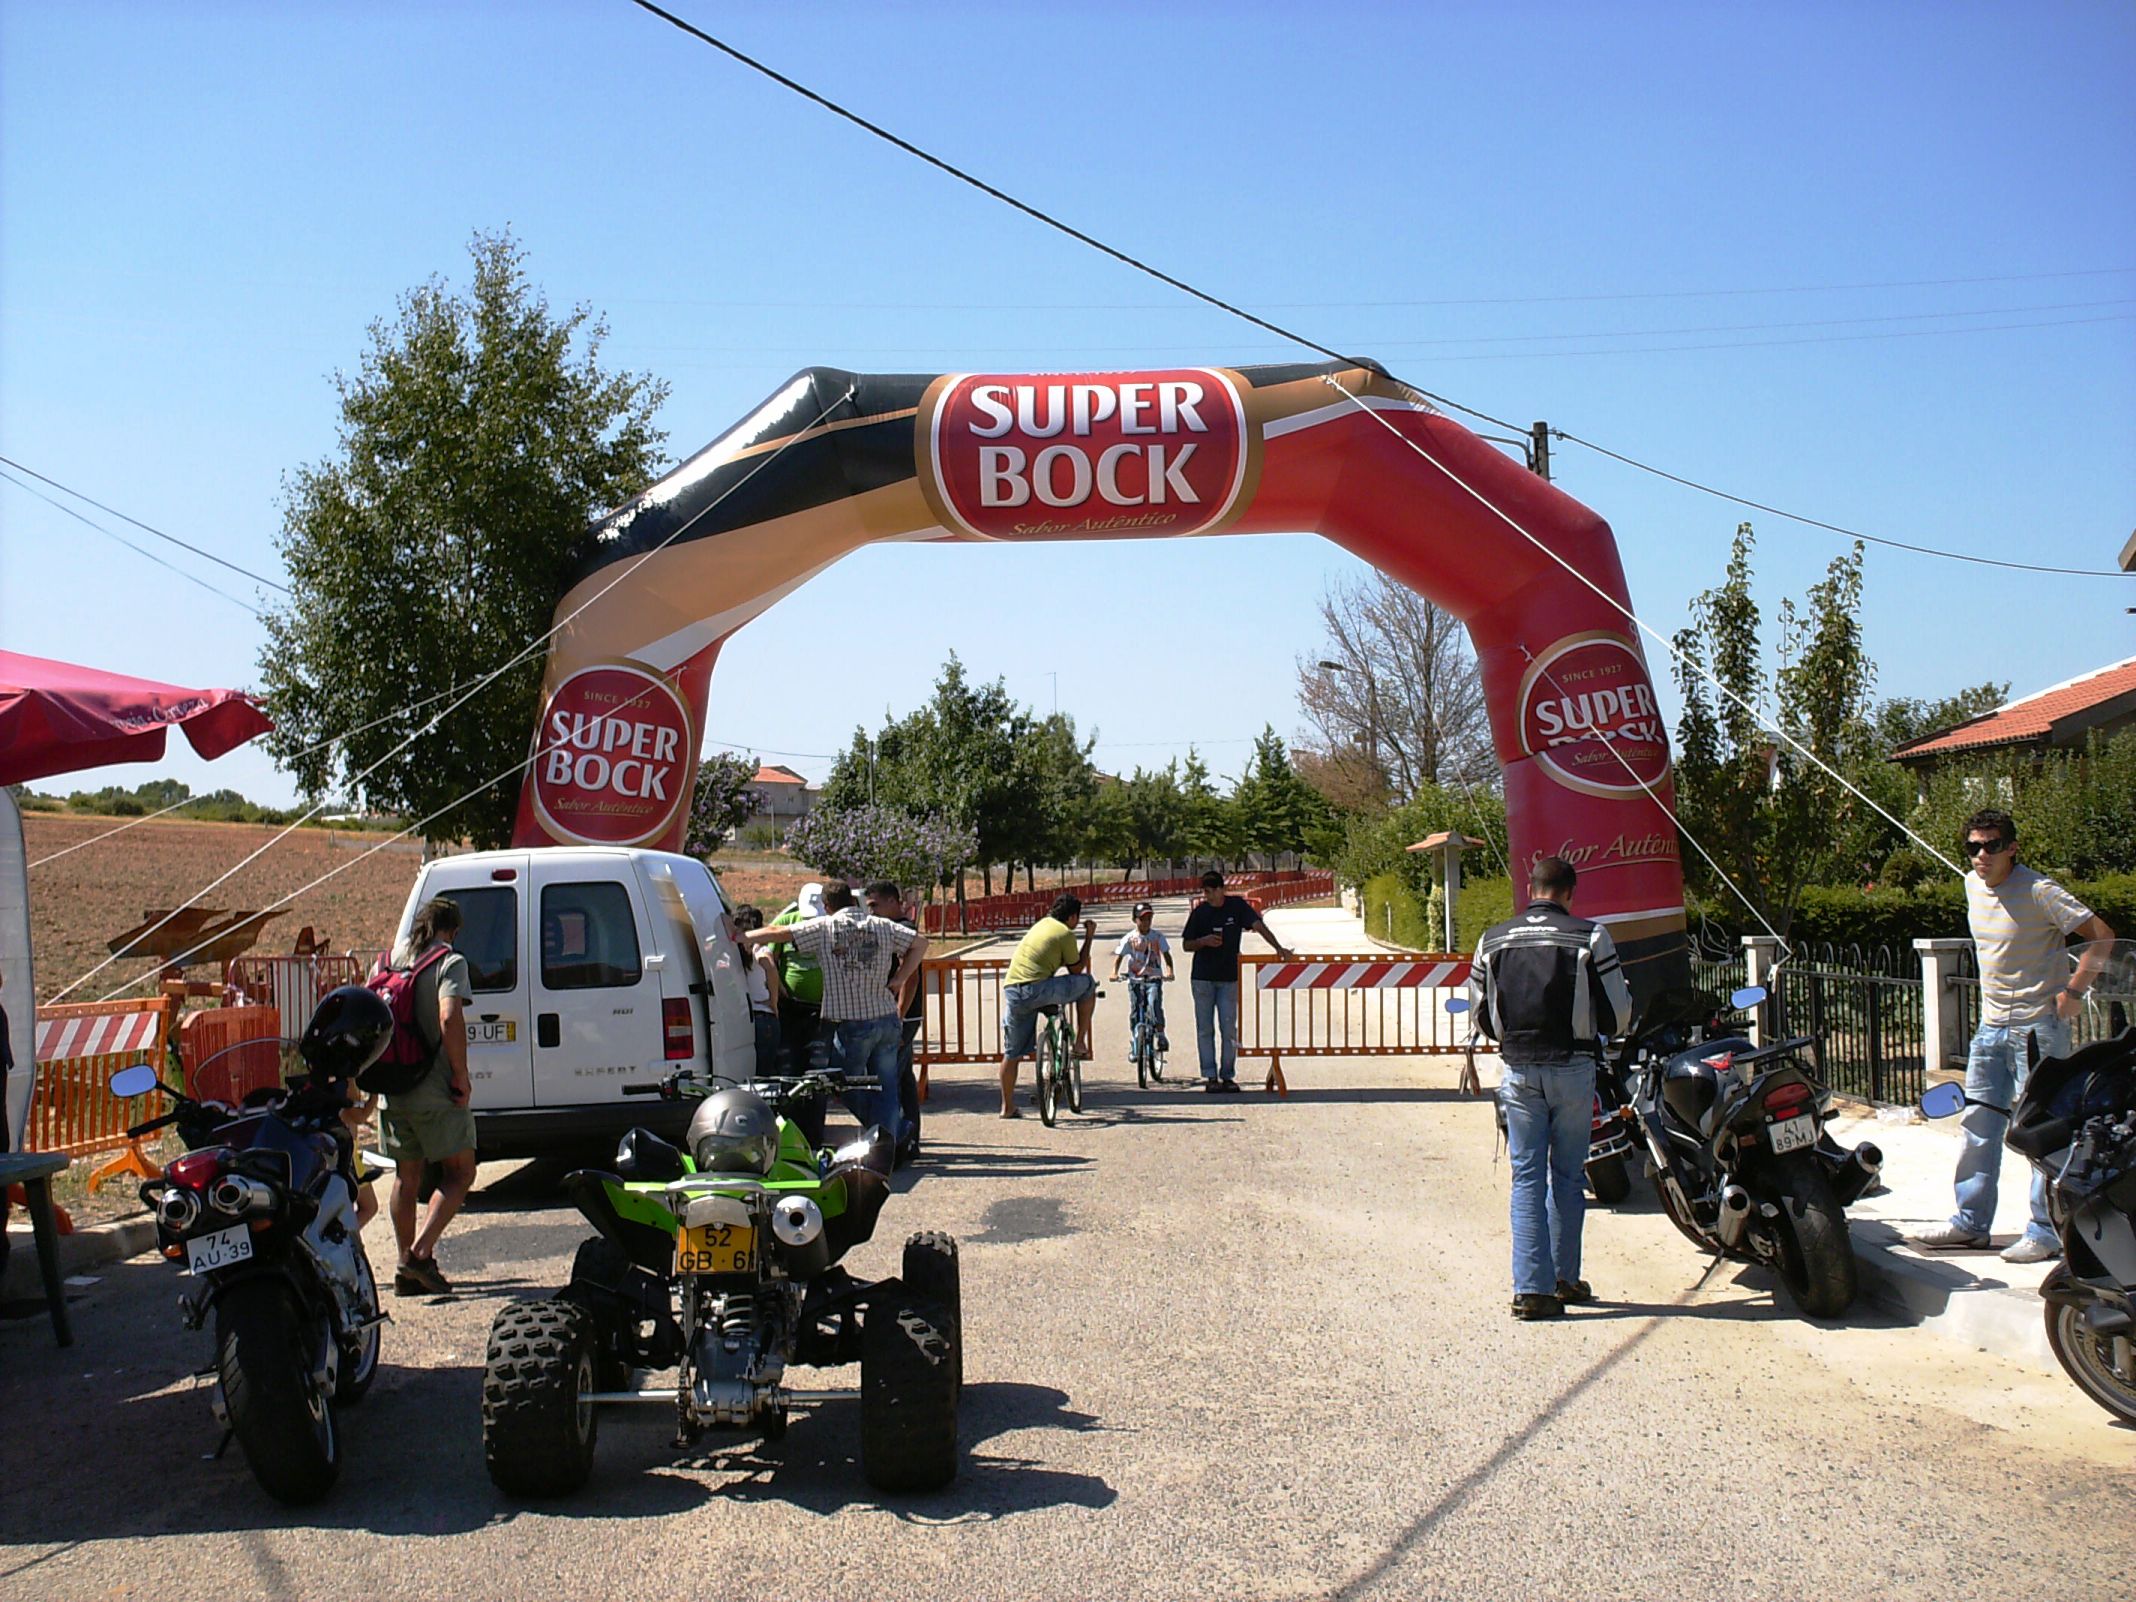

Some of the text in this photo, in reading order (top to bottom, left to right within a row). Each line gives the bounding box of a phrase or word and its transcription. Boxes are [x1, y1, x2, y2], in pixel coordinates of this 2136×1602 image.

[969, 382, 1208, 438] SUPER
[978, 443, 1201, 508] BOCK
[1009, 520, 1070, 536] Sabor
[1562, 664, 1622, 683] SINCE 1927
[584, 690, 618, 704] SINCE
[1535, 683, 1656, 736] SUPER
[549, 710, 679, 763] SUPER
[546, 750, 670, 801] BOCK
[553, 797, 591, 811] Sabor
[1532, 838, 1599, 865] Sbor
[206, 1231, 231, 1250] 74
[705, 1227, 732, 1247] 52
